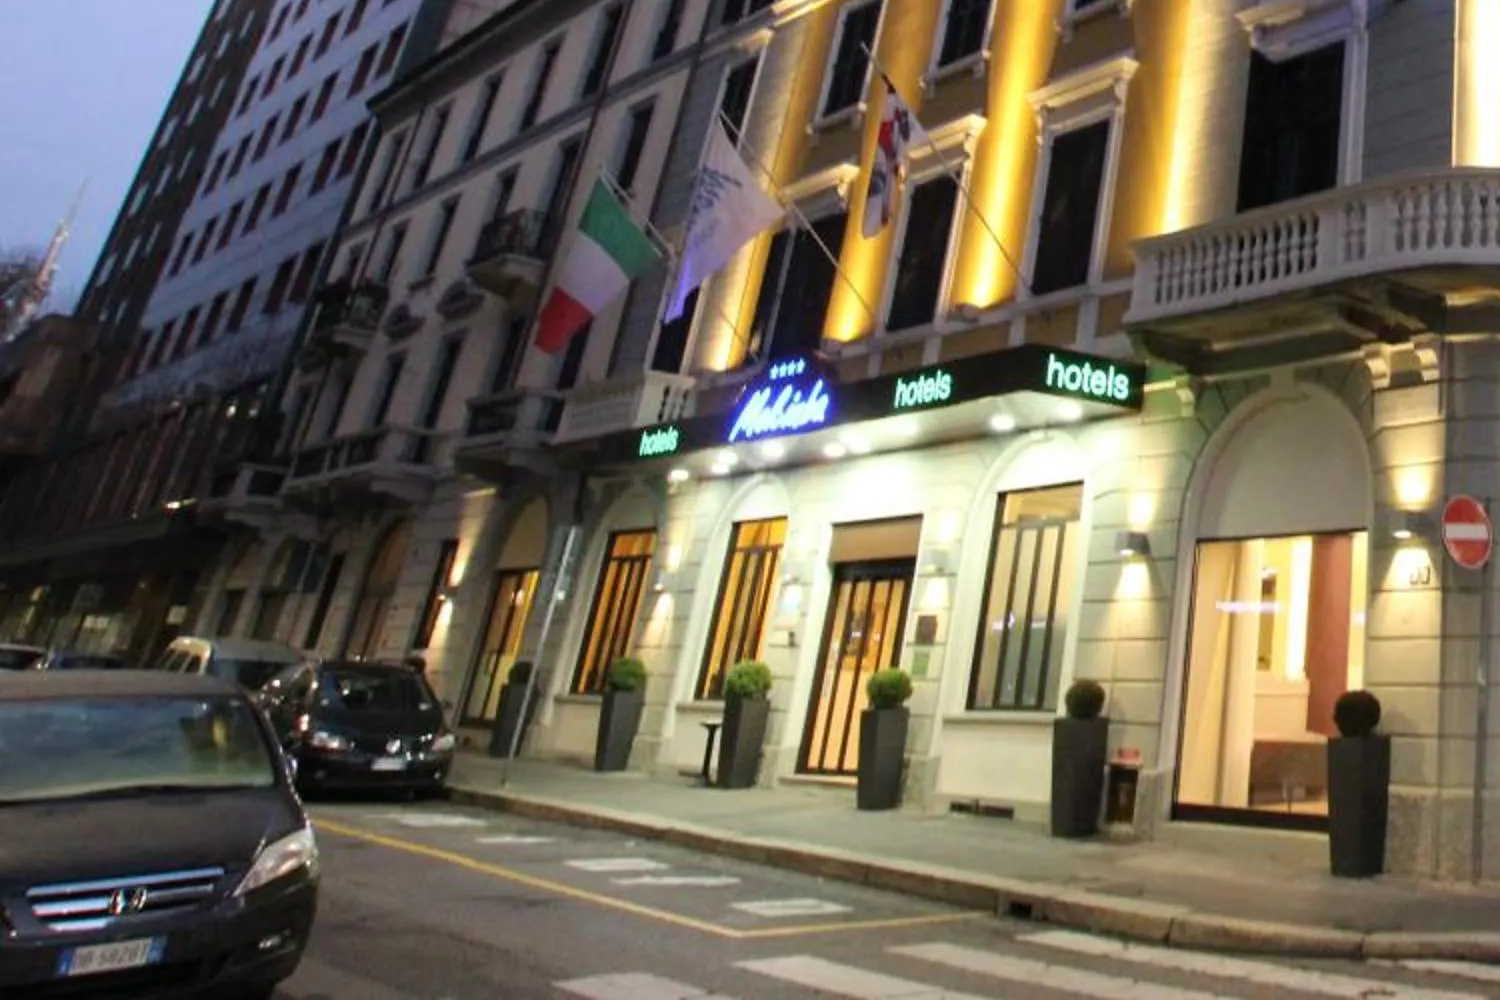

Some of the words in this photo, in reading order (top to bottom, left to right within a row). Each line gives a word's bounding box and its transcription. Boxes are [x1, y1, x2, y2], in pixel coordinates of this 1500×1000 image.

[893, 369, 952, 410] hotels
[1046, 354, 1129, 400] hotels
[639, 426, 679, 456] hotels
